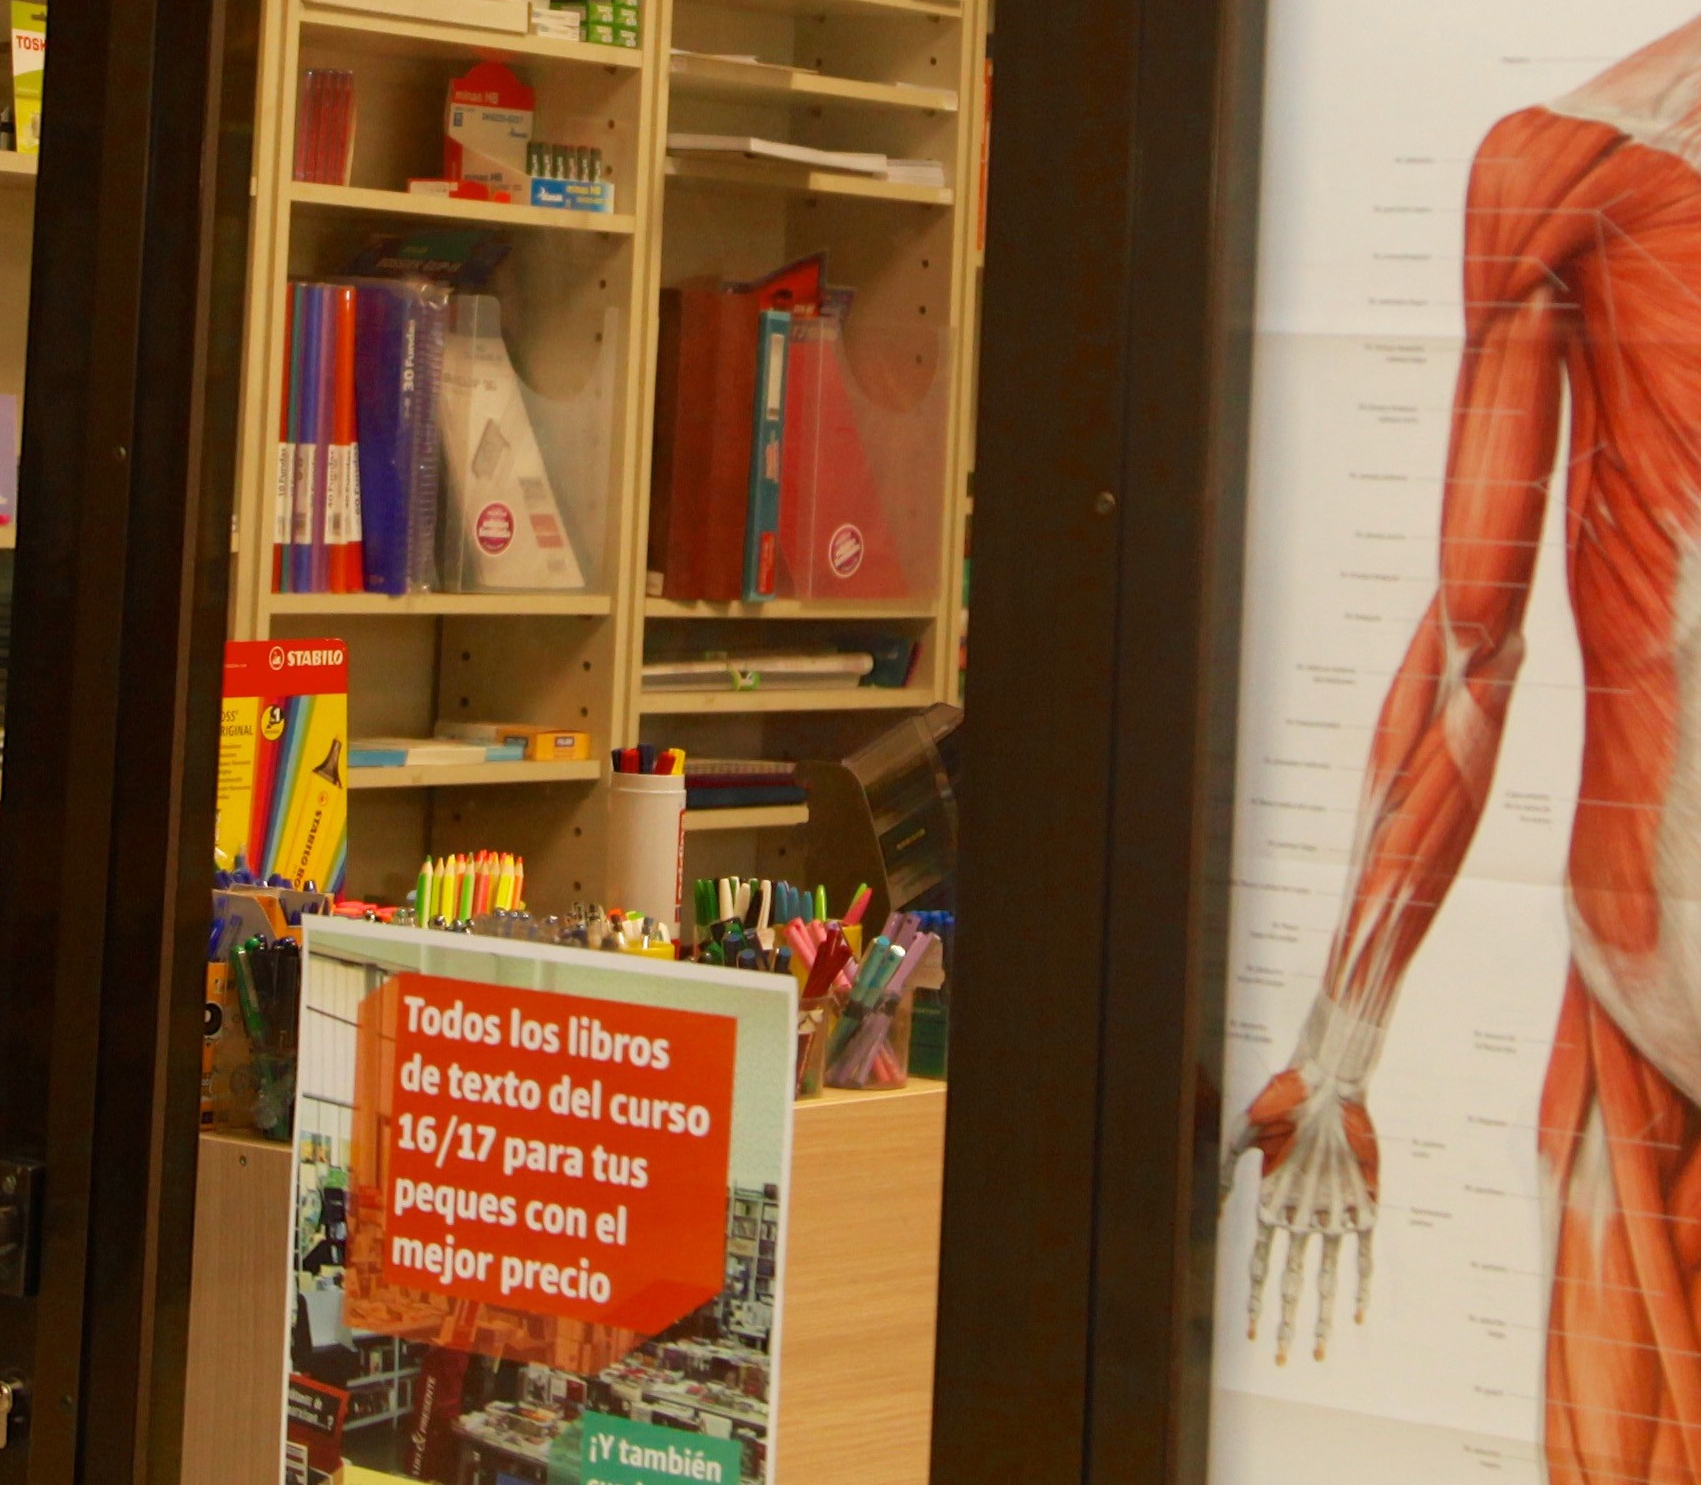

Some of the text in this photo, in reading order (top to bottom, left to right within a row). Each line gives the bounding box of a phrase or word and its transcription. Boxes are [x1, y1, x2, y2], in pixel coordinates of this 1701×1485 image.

[403, 319, 416, 392] 30 Fundas
[286, 649, 344, 666] STABILO
[301, 810, 323, 862] STABILO
[404, 995, 671, 1070] Todos los libros
[400, 1052, 712, 1138] de texto del curso
[397, 1112, 650, 1189] 16/17 para tus
[393, 1177, 628, 1246] peques con el
[391, 1234, 613, 1304] mejor precio
[589, 1431, 722, 1484] ¡Y también
